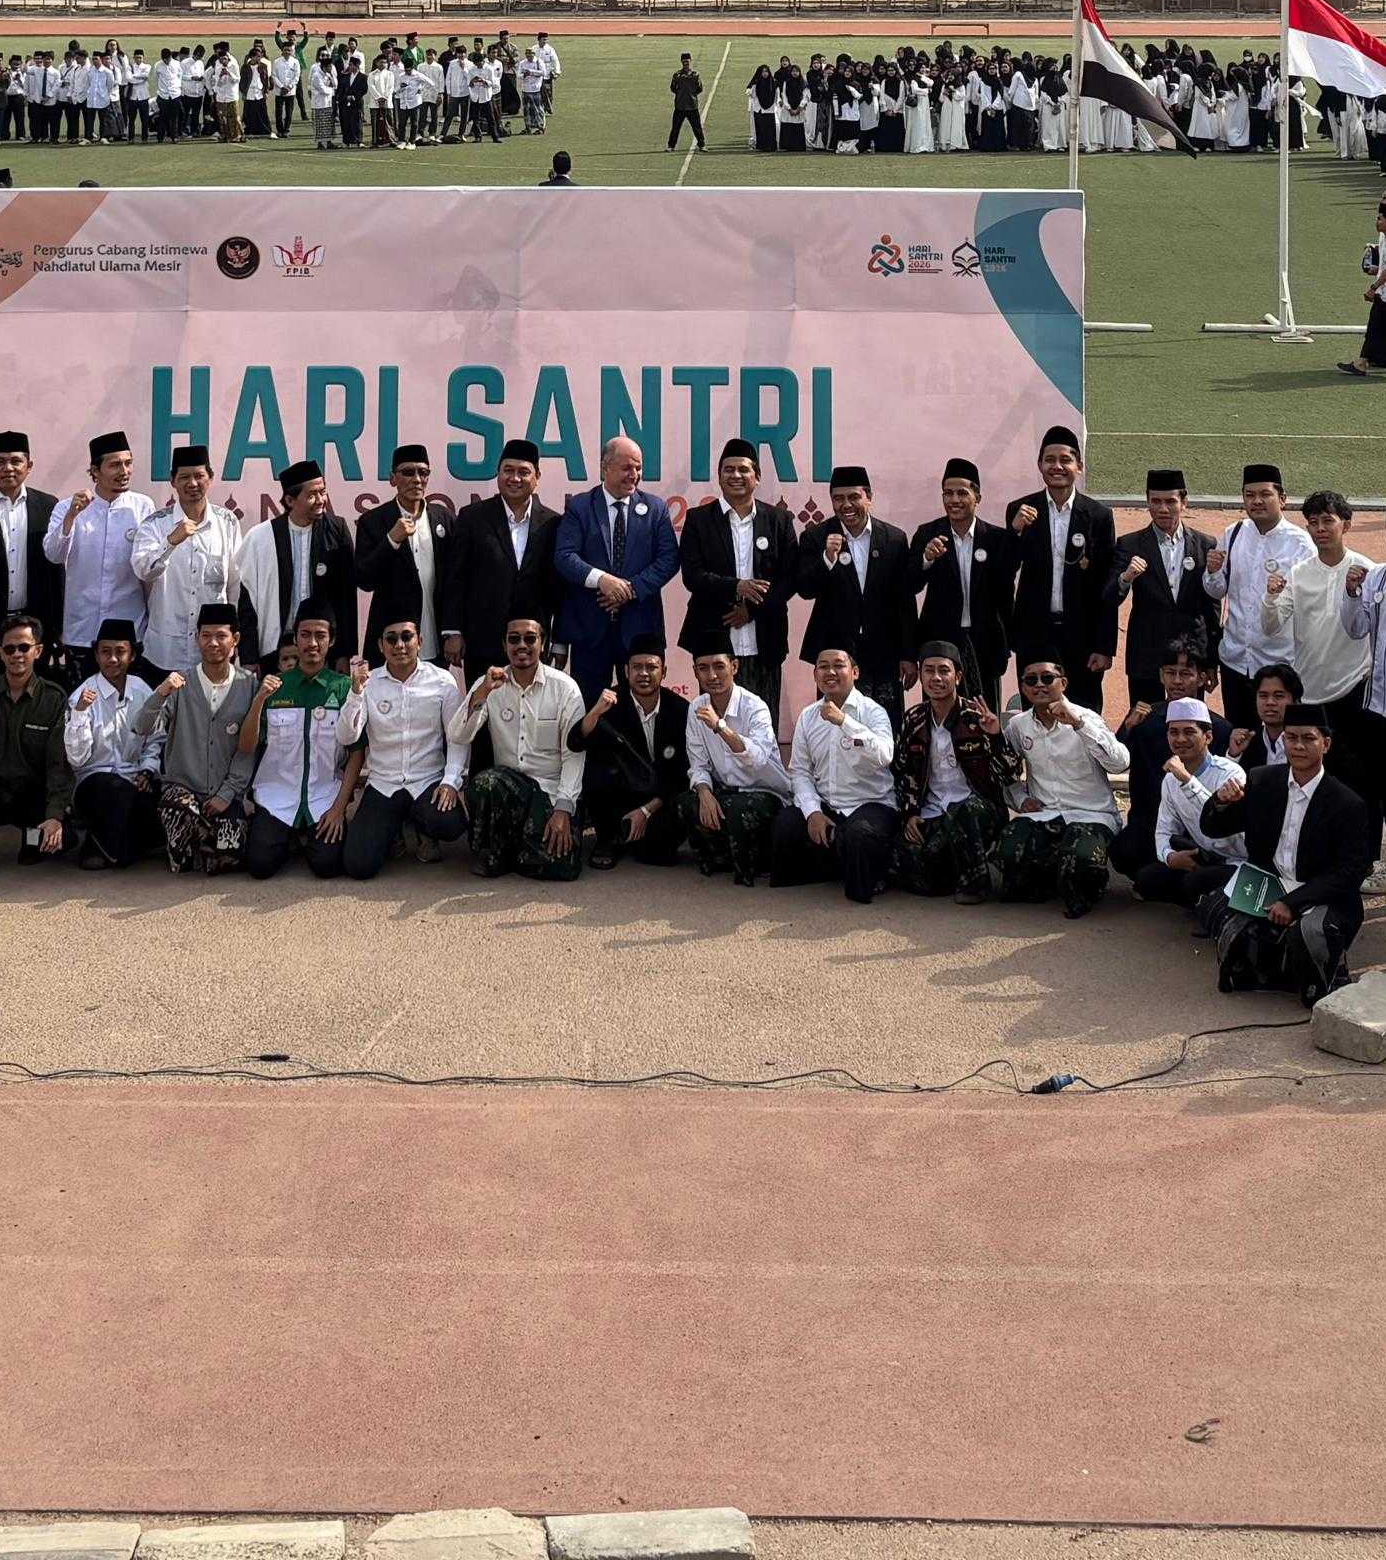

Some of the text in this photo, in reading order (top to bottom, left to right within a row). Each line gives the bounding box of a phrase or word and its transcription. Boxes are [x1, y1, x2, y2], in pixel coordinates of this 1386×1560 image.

[34, 243, 208, 258] Pengurus Cabang Istimewa
[908, 245, 931, 253] HARI
[99, 260, 140, 272] Ulama
[144, 260, 181, 272] Mesir
[151, 364, 833, 484] HARI SANTRI
